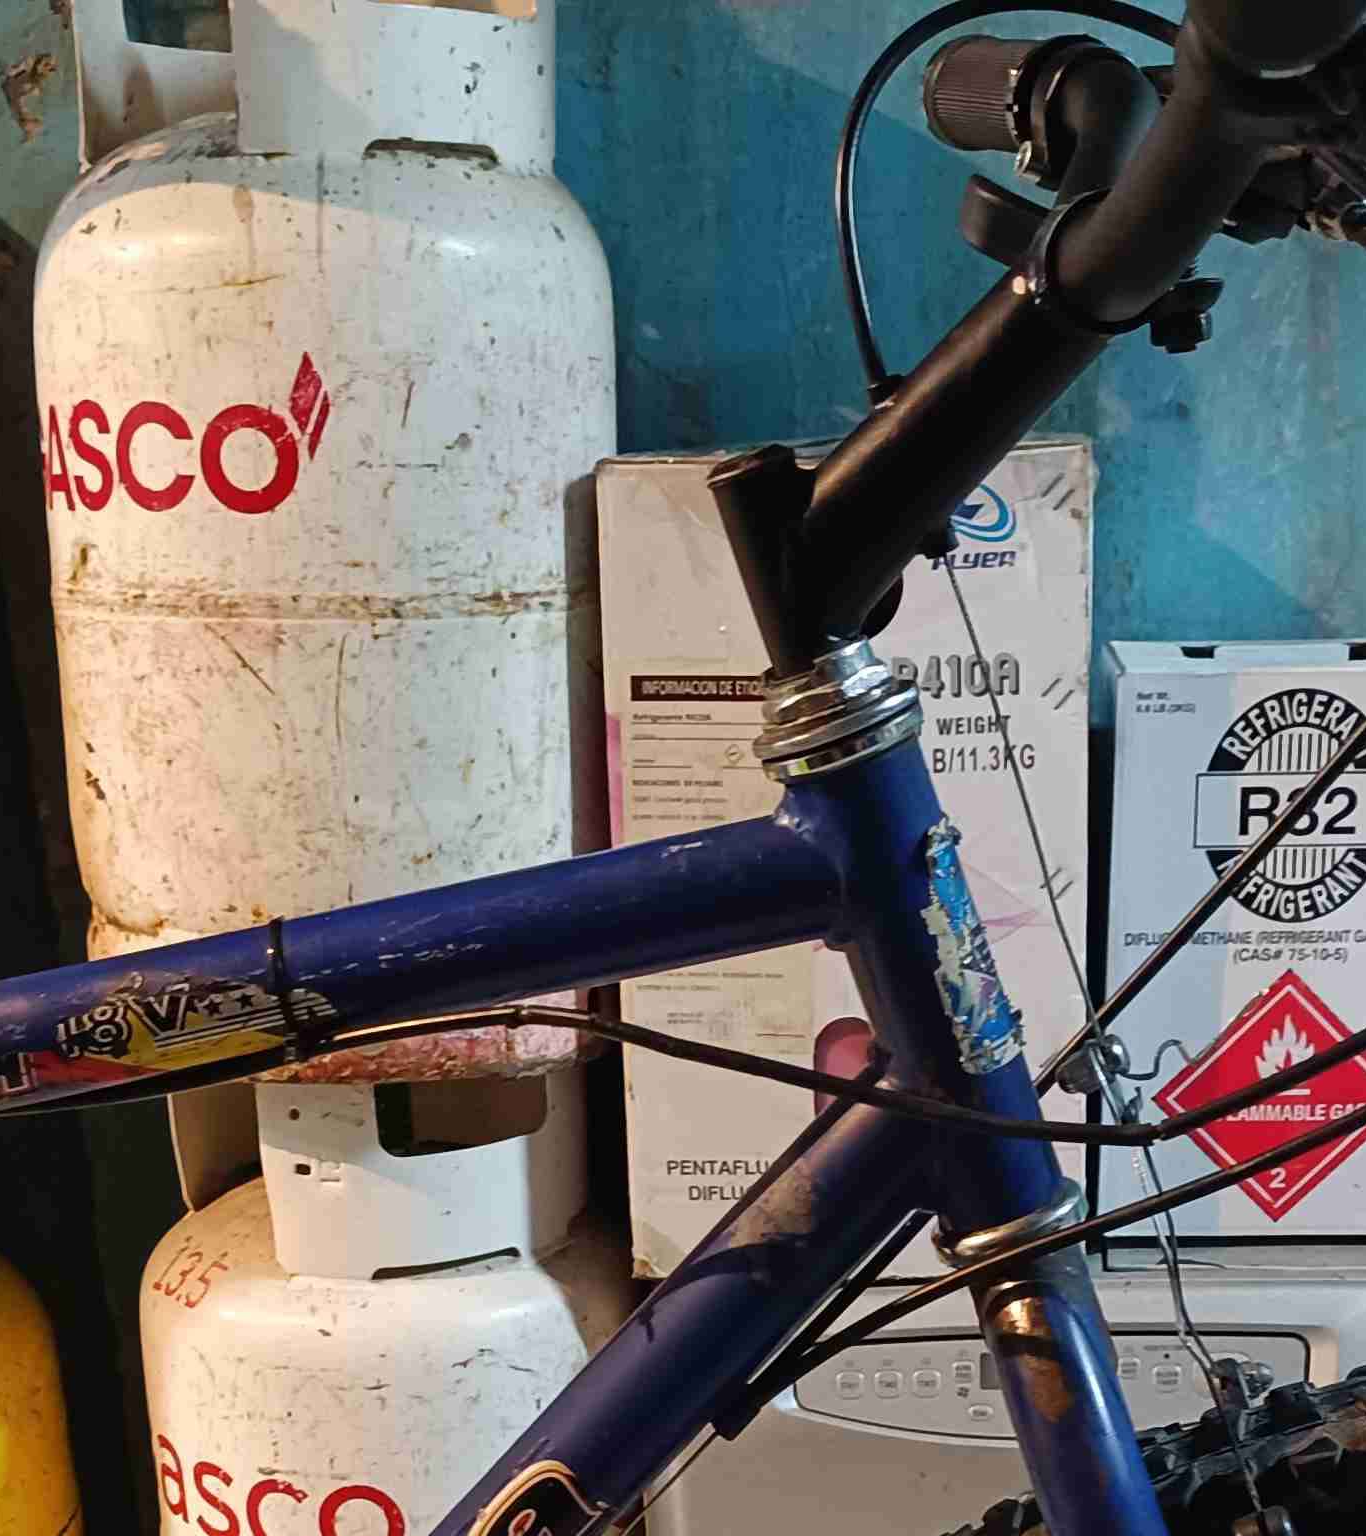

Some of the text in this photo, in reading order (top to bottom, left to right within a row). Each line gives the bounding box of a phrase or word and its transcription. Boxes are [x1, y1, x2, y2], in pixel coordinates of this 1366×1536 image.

[42, 399, 300, 515] ASCO
[937, 714, 1012, 736] WEIGHT
[1238, 786, 1359, 837] R32
[1218, 1103, 1326, 1122] LAMMABLE
[1269, 1167, 1287, 1189] 2
